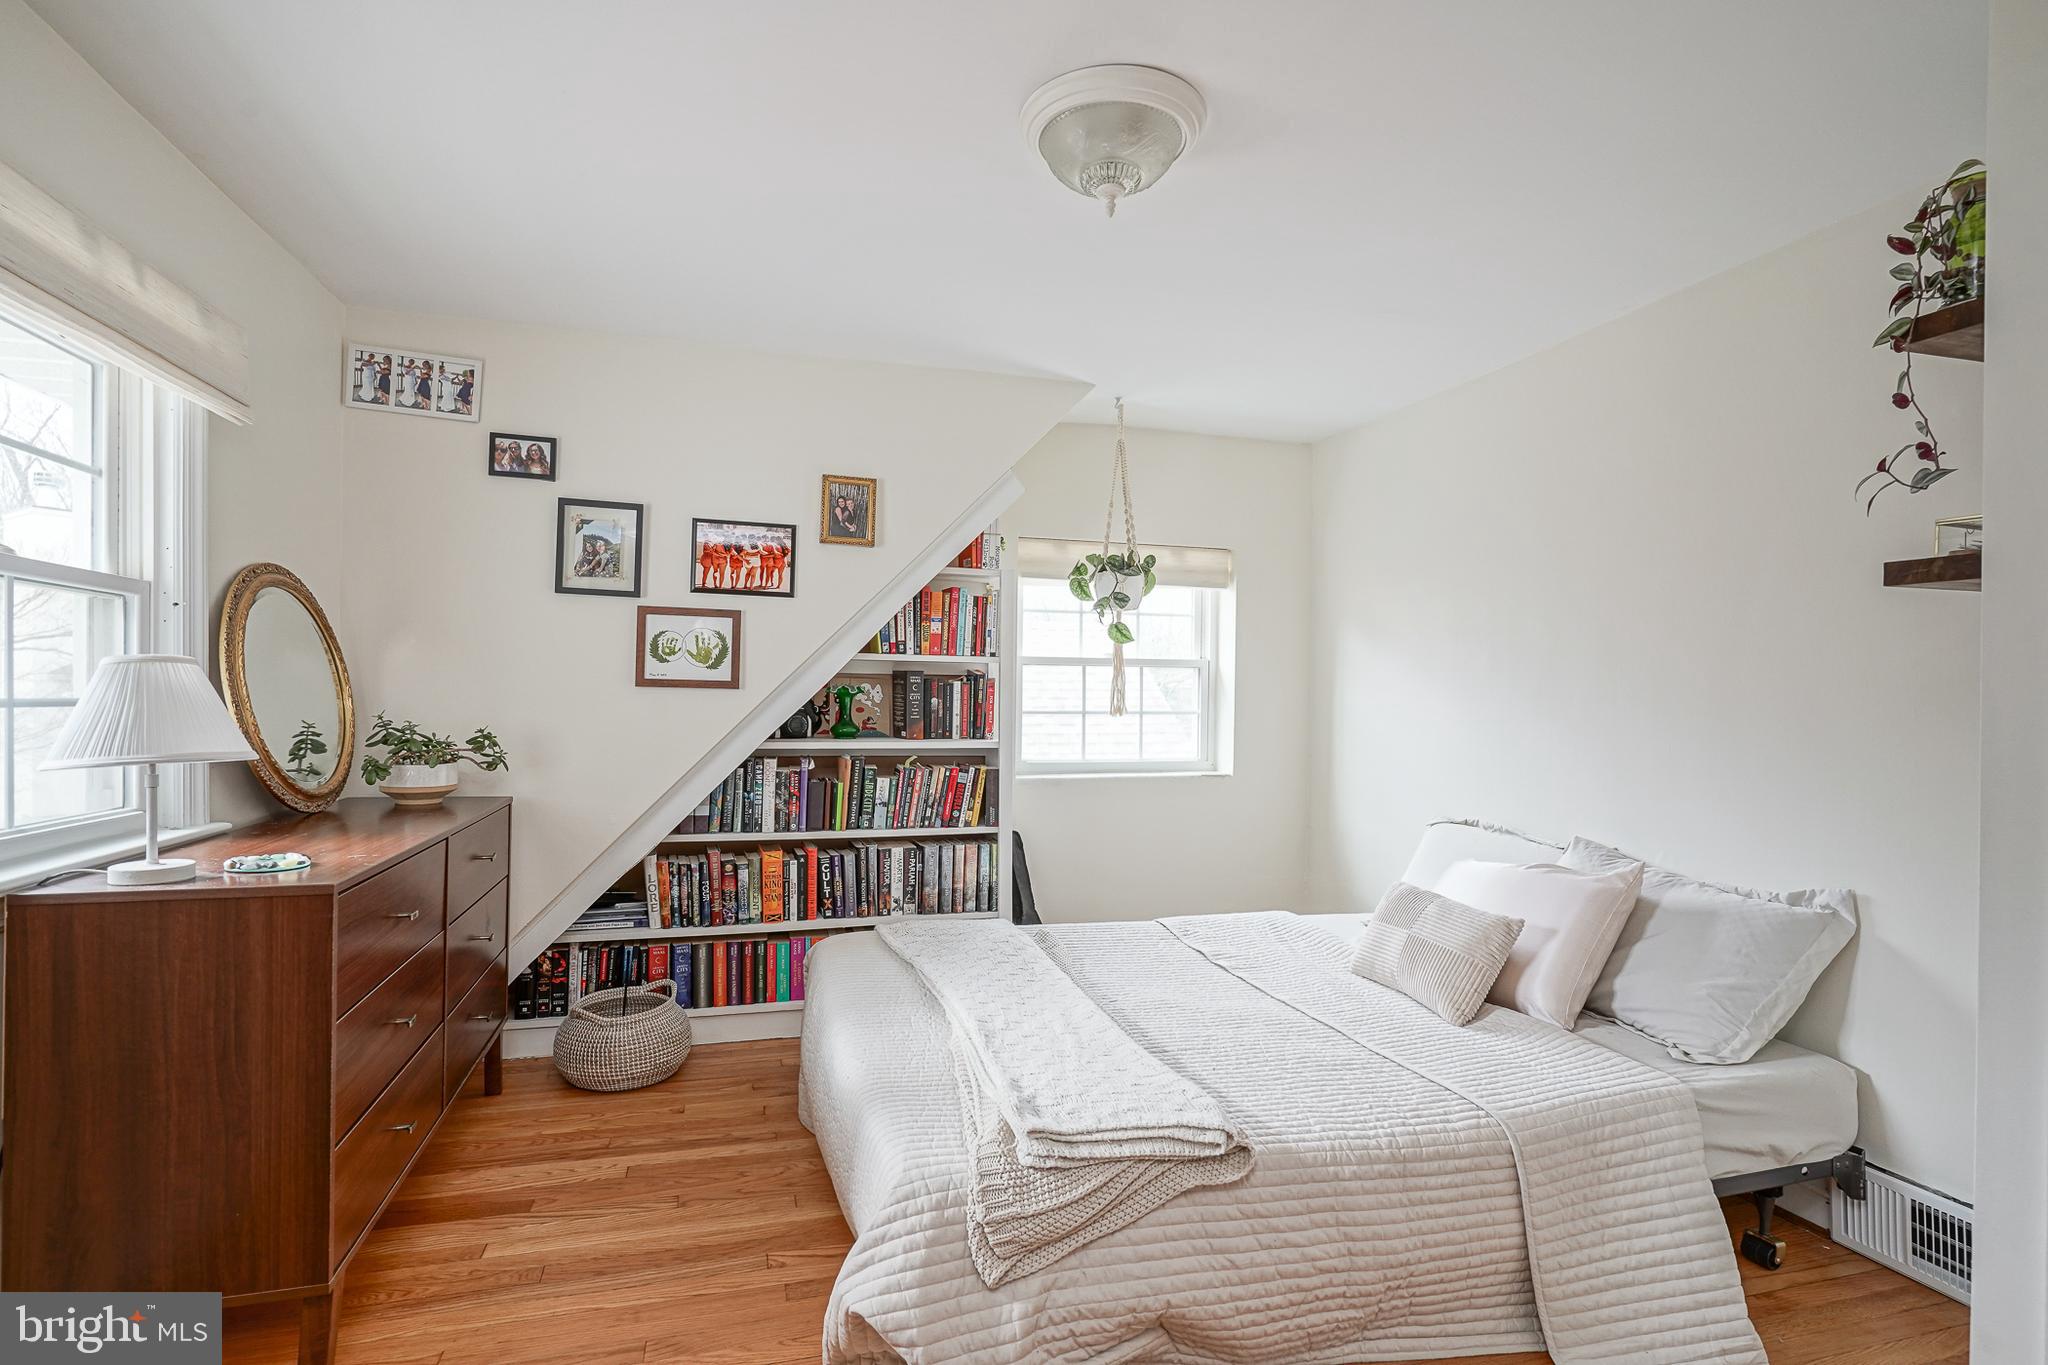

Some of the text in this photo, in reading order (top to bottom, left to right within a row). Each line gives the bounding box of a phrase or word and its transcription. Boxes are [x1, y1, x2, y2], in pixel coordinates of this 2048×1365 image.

[755, 764, 763, 805] CAMP ZERO
[853, 760, 861, 784] STEPHEN
[862, 780, 875, 813] JADE CITY
[952, 783, 966, 811] DRACULA
[764, 880, 782, 889] KING
[882, 857, 891, 886] TRAITOR
[895, 857, 903, 885] MARTYR
[908, 858, 916, 886] PARIAH
[648, 874, 659, 914] LORE
[701, 880, 711, 902] FOUR
